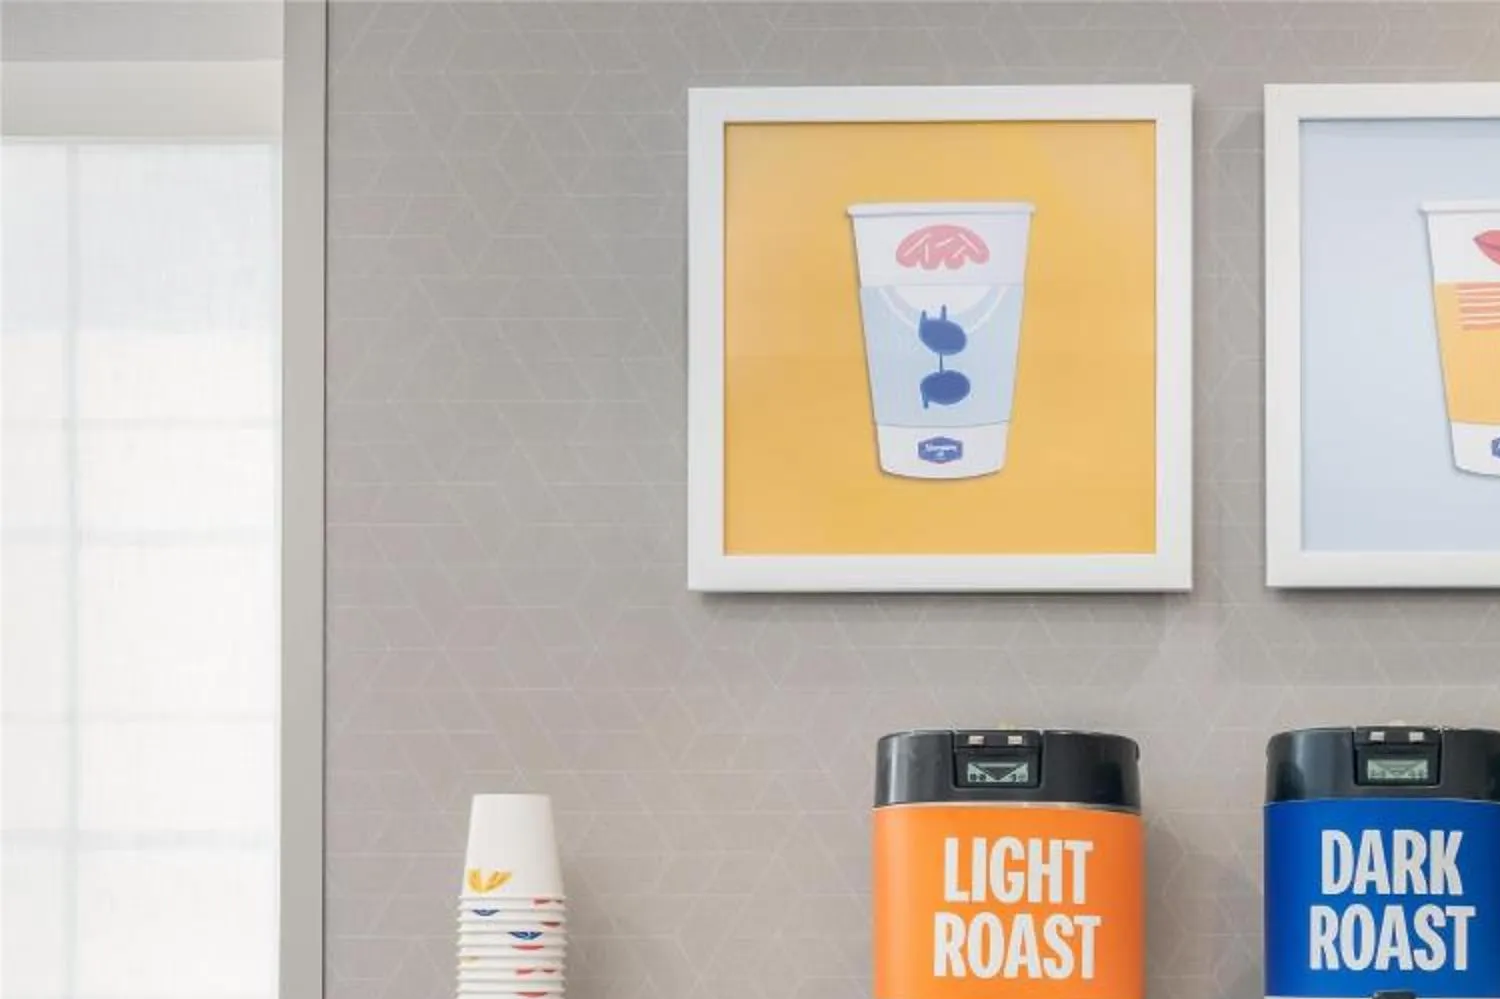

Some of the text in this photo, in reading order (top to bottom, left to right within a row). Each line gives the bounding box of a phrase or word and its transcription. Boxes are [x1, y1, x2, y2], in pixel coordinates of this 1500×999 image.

[943, 836, 1094, 905] LIGHT
[1321, 829, 1464, 896] DARK
[933, 912, 1101, 980] ROAST
[1308, 904, 1477, 972] ROAST
